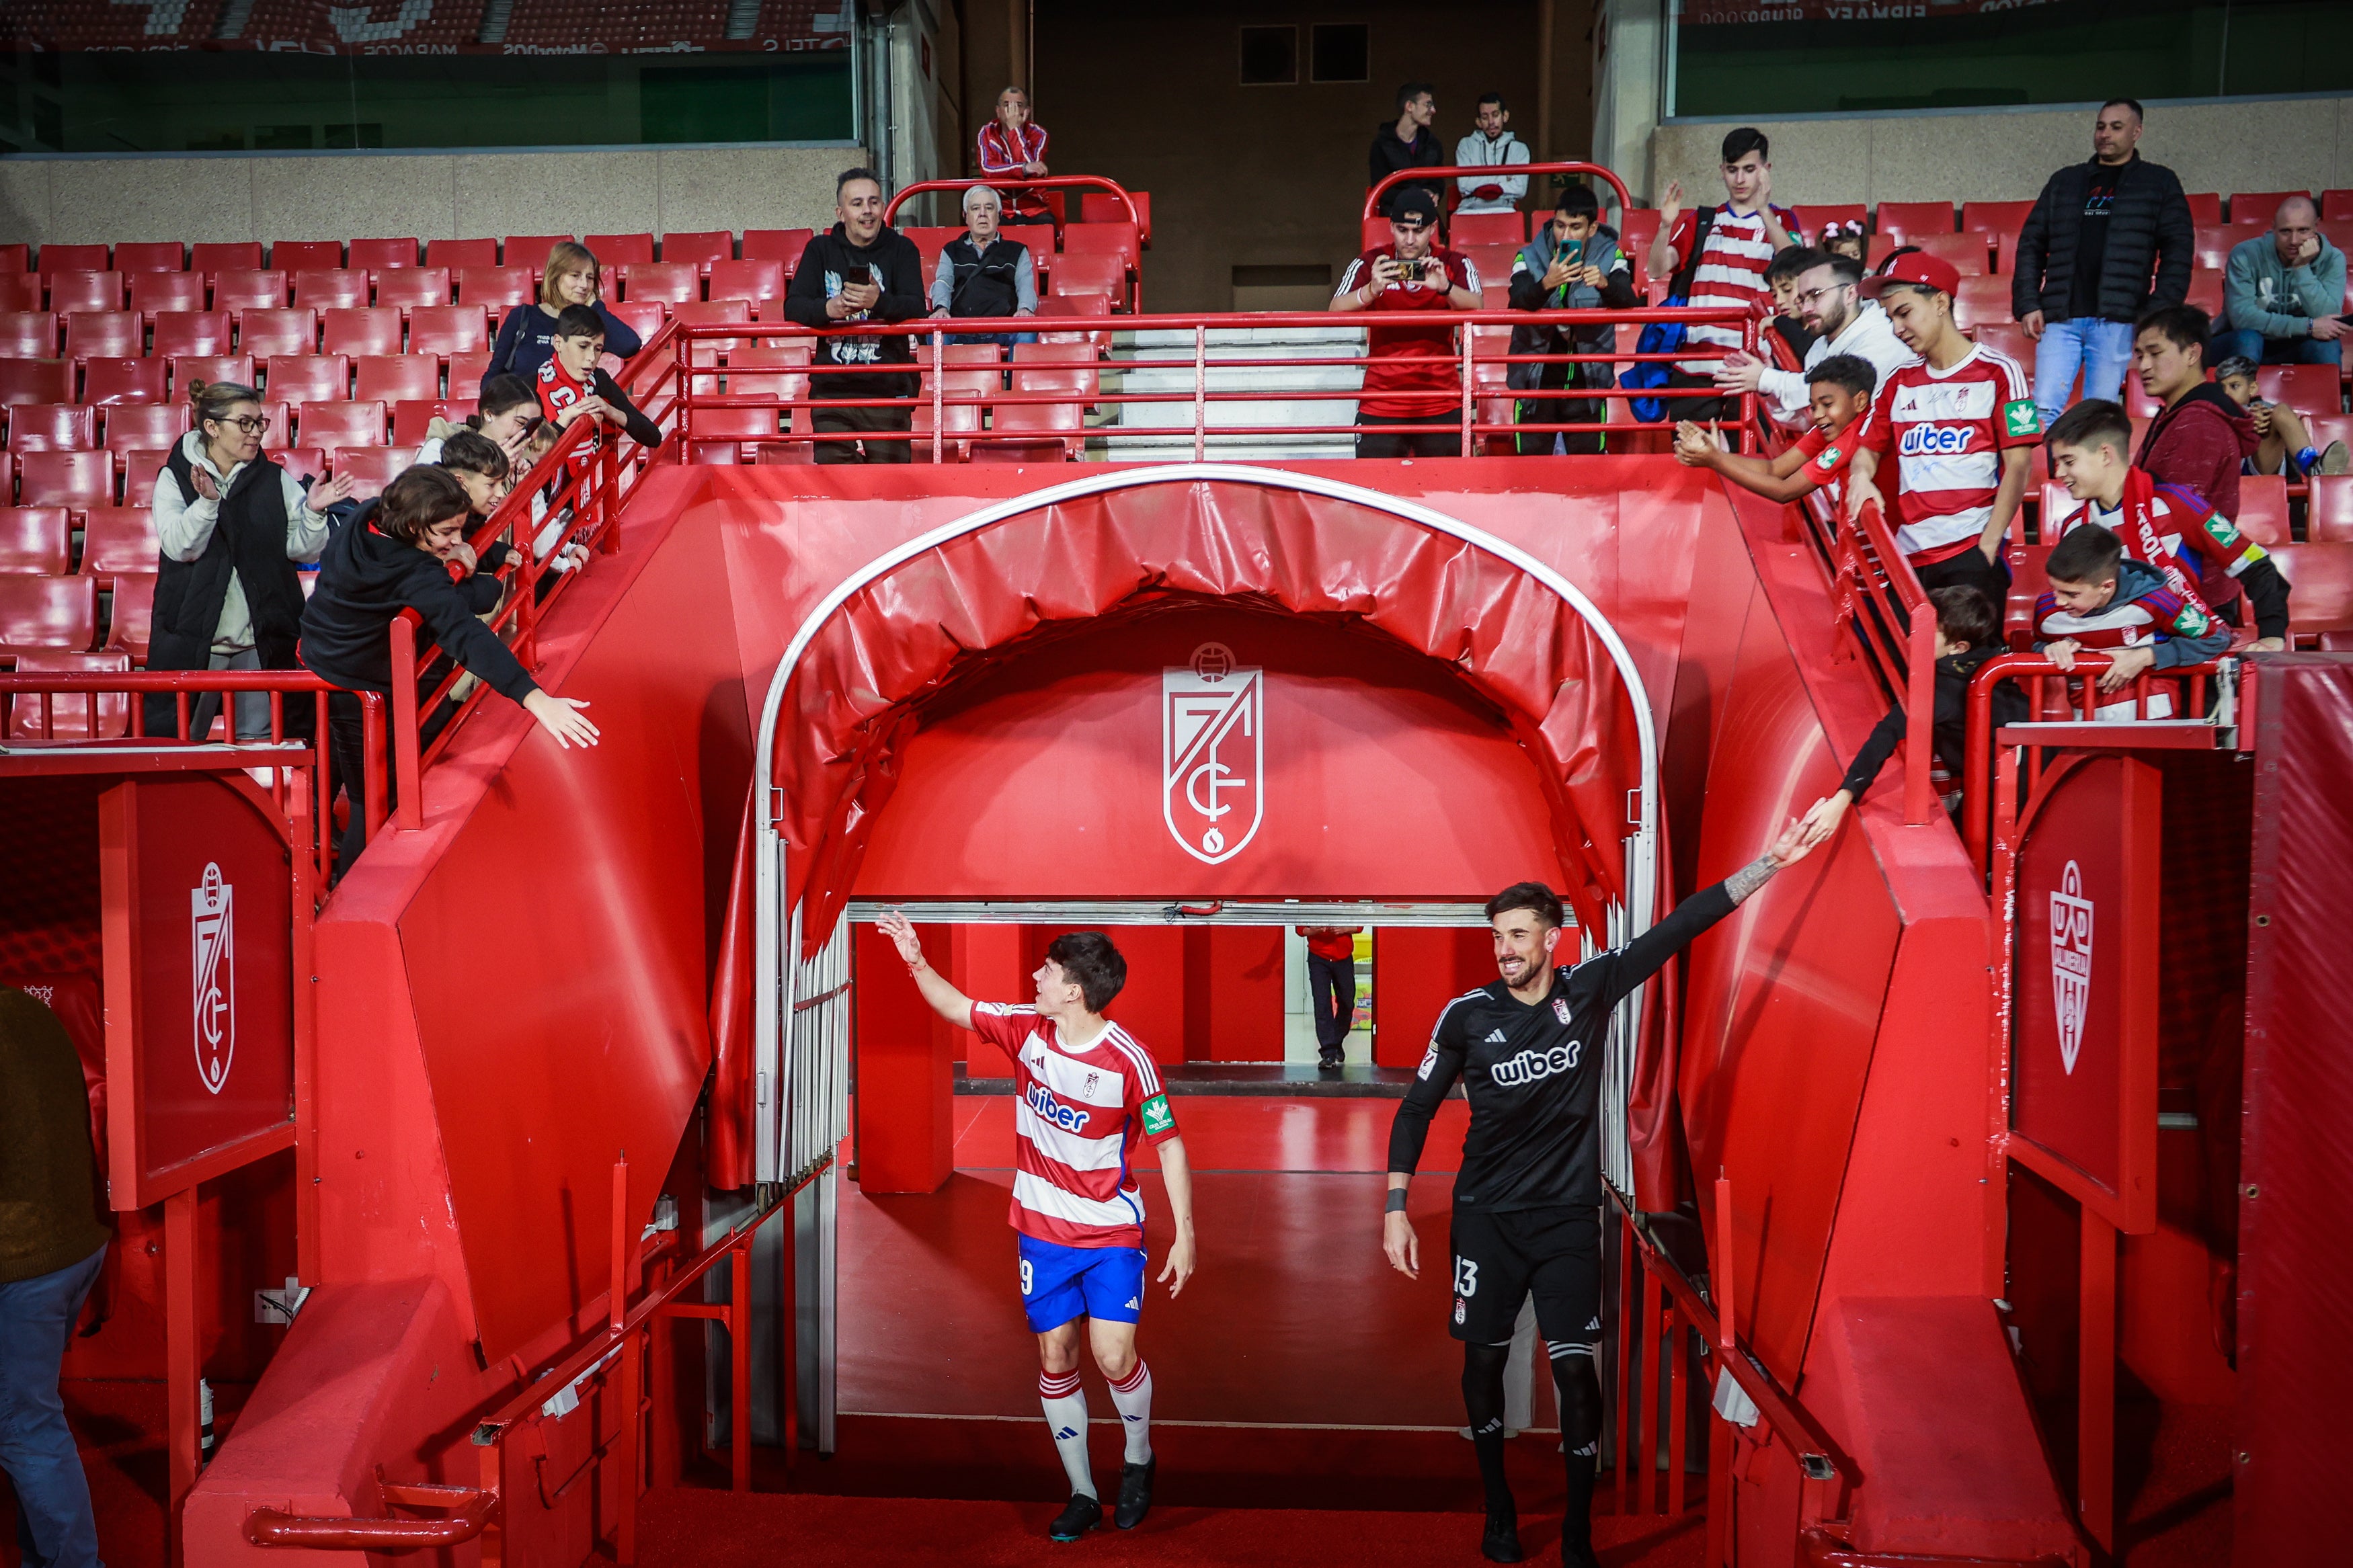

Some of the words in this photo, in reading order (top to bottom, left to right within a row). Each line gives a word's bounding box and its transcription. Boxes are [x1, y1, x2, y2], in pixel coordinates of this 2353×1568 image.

[1491, 1040, 1581, 1086] wiber
[1027, 1081, 1090, 1133] wiber
[1453, 1254, 1478, 1297] 13
